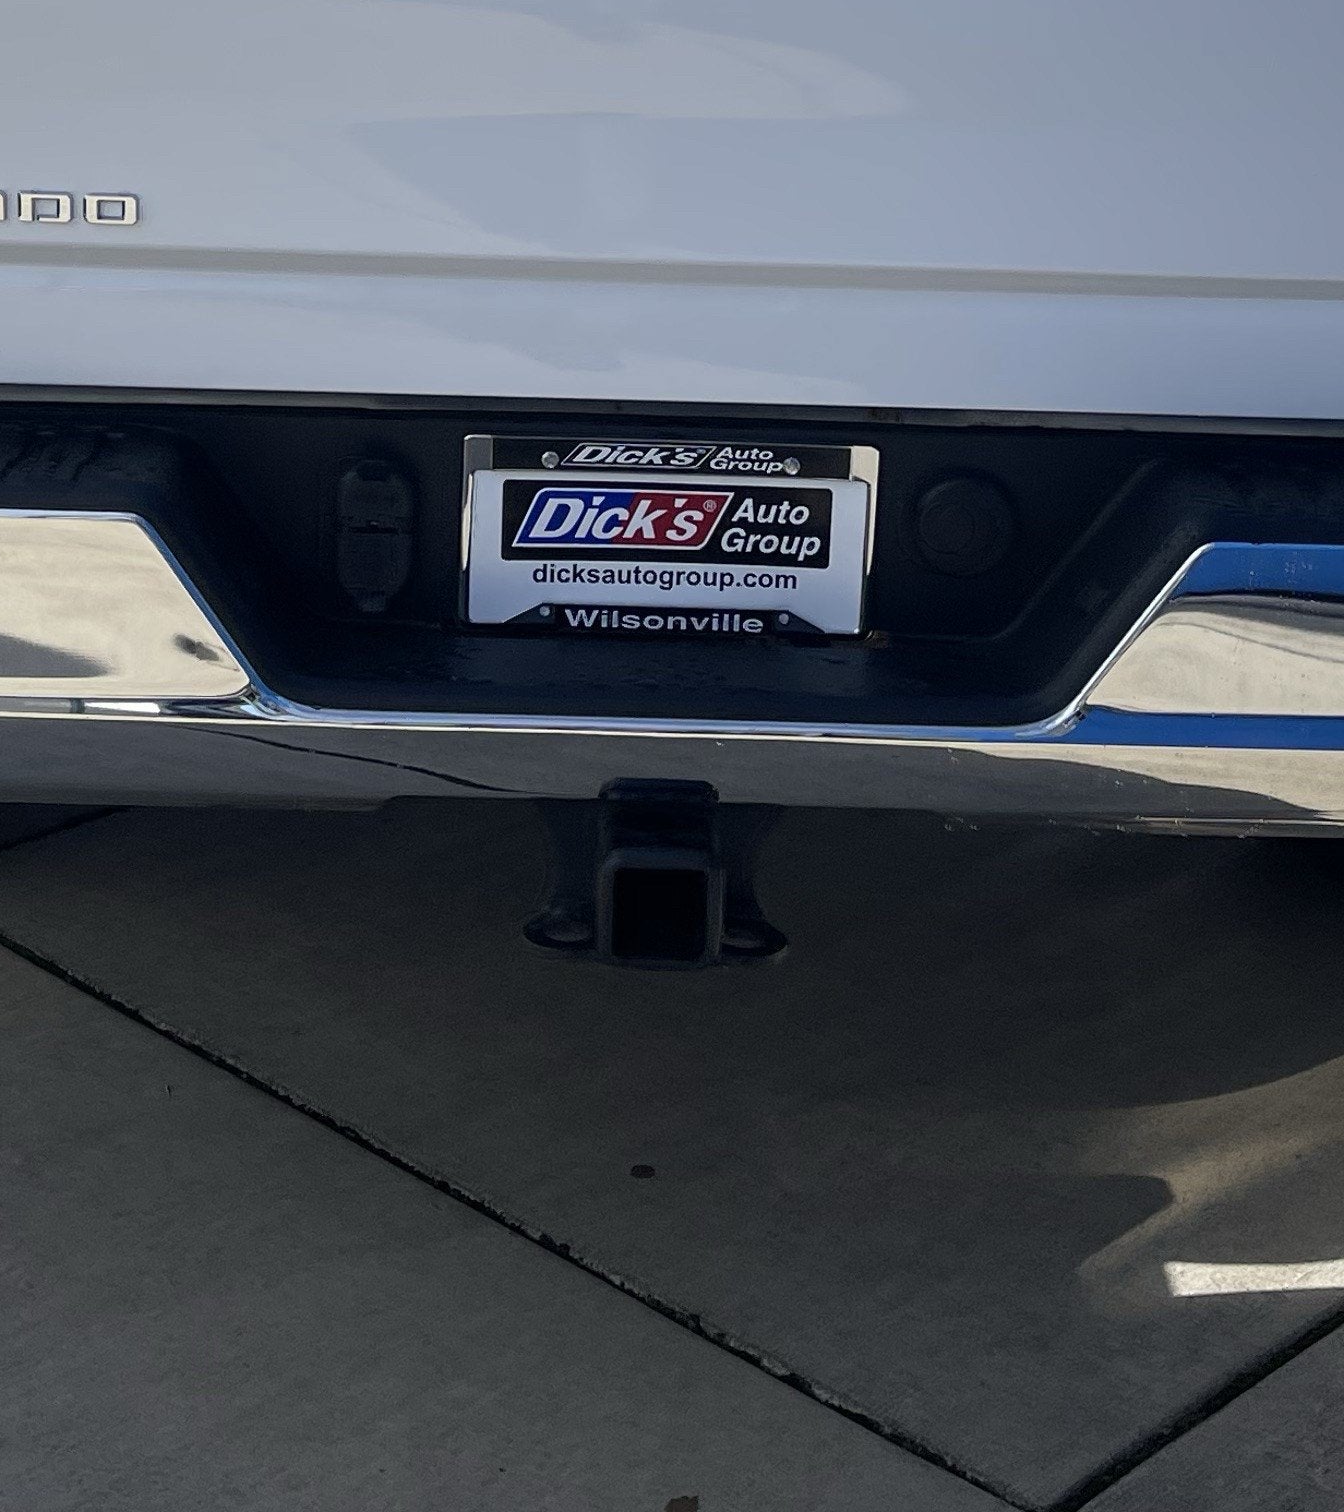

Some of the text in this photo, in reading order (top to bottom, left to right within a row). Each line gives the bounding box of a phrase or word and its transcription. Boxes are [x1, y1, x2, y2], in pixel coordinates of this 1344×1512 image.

[572, 444, 774, 467] Dick's Auto
[709, 458, 784, 474] Group
[528, 495, 810, 542] Dick's Auto
[721, 527, 822, 561] Group
[532, 564, 798, 591] dicksautogroup.com
[564, 608, 764, 634] Wilsonville
